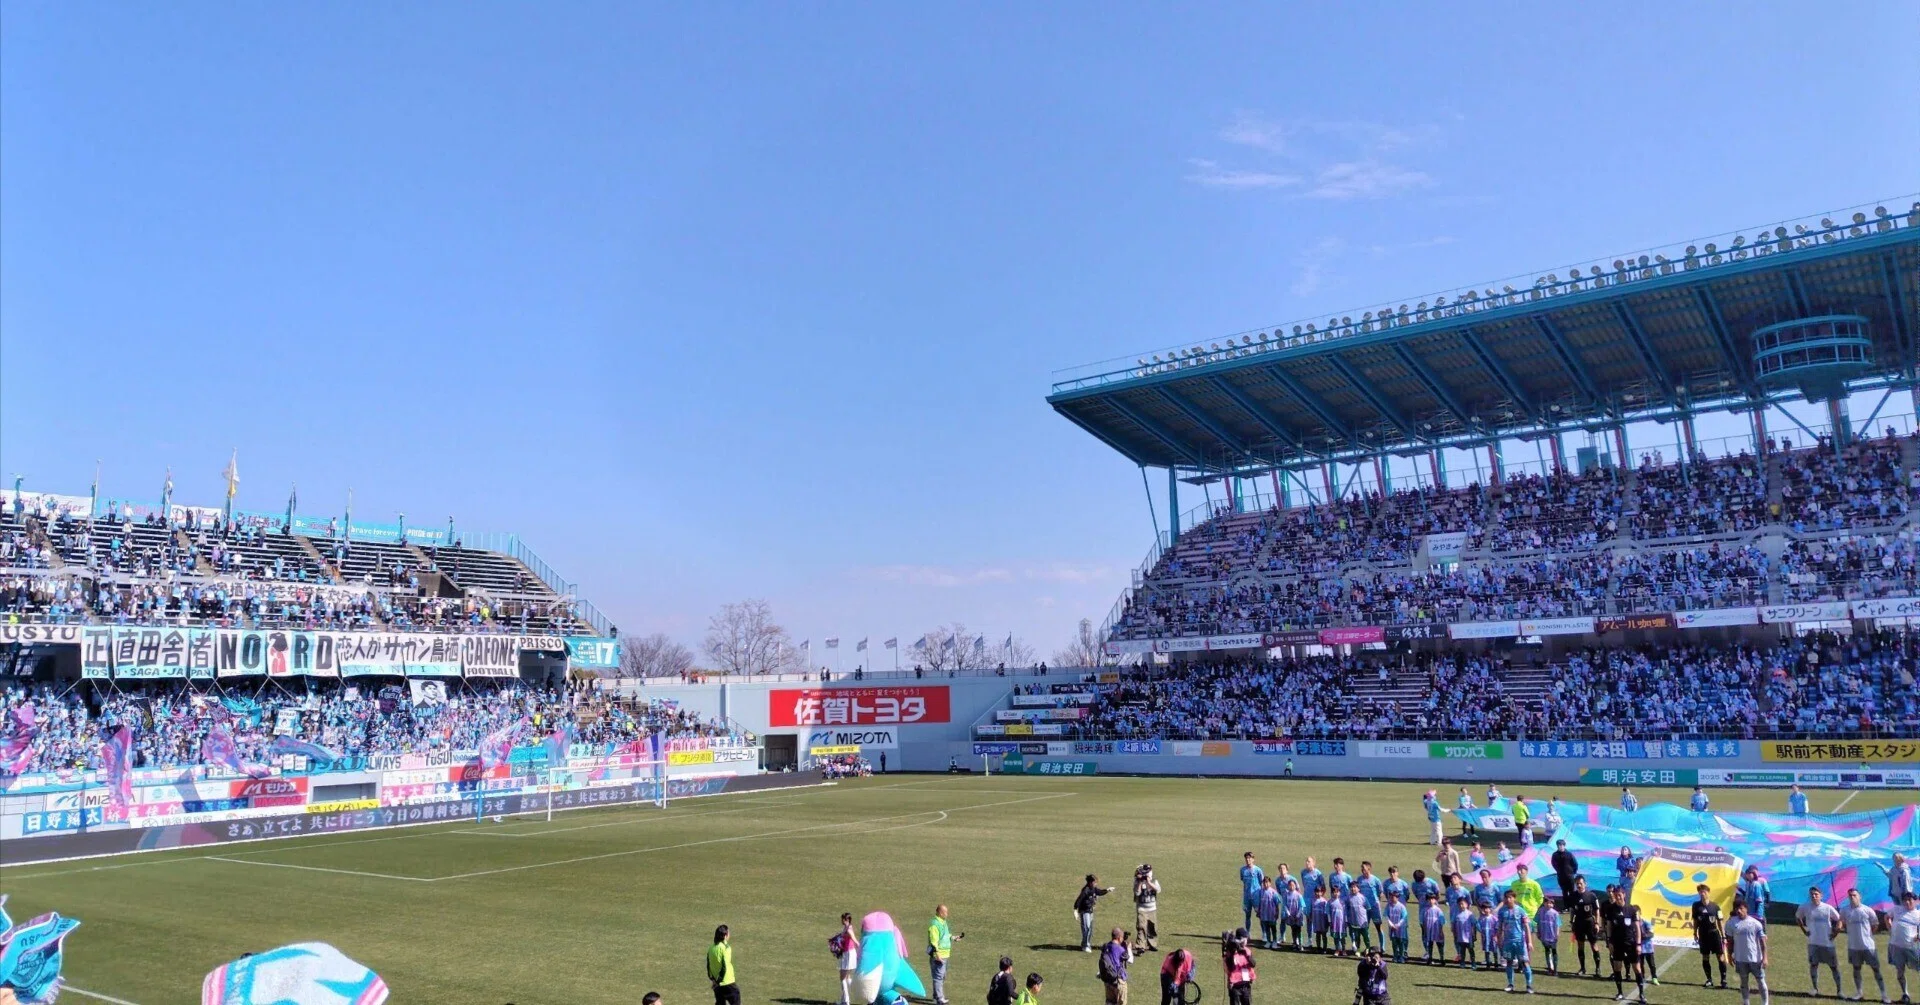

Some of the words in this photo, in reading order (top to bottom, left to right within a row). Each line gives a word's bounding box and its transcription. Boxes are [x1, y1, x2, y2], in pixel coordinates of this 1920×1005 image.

[1768, 606, 1822, 619] サニクリーン
[84, 628, 213, 669] 正直田舎者
[520, 637, 562, 650] PRISCO
[466, 637, 516, 666] CAFONE
[130, 668, 160, 677] SAGA
[467, 667, 518, 677] FOOTBALL
[794, 697, 926, 725] 佐賀トヨタ
[836, 732, 892, 745] MIZOTA
[1297, 741, 1345, 755] 今津佑太
[1384, 746, 1412, 754] FELICE
[1445, 745, 1488, 758] サロンパス
[1776, 744, 1917, 759] 駅前不動産スタジ
[715, 749, 755, 761] アサヒビール
[1040, 762, 1084, 774] 明治安田
[1602, 769, 1676, 784] 明治安田
[27, 809, 101, 831] 日野翔太
[263, 819, 303, 833] 立てよ
[310, 811, 375, 830] 共に行こう
[1655, 908, 1693, 920] FAI
[1650, 917, 1695, 930] PLA
